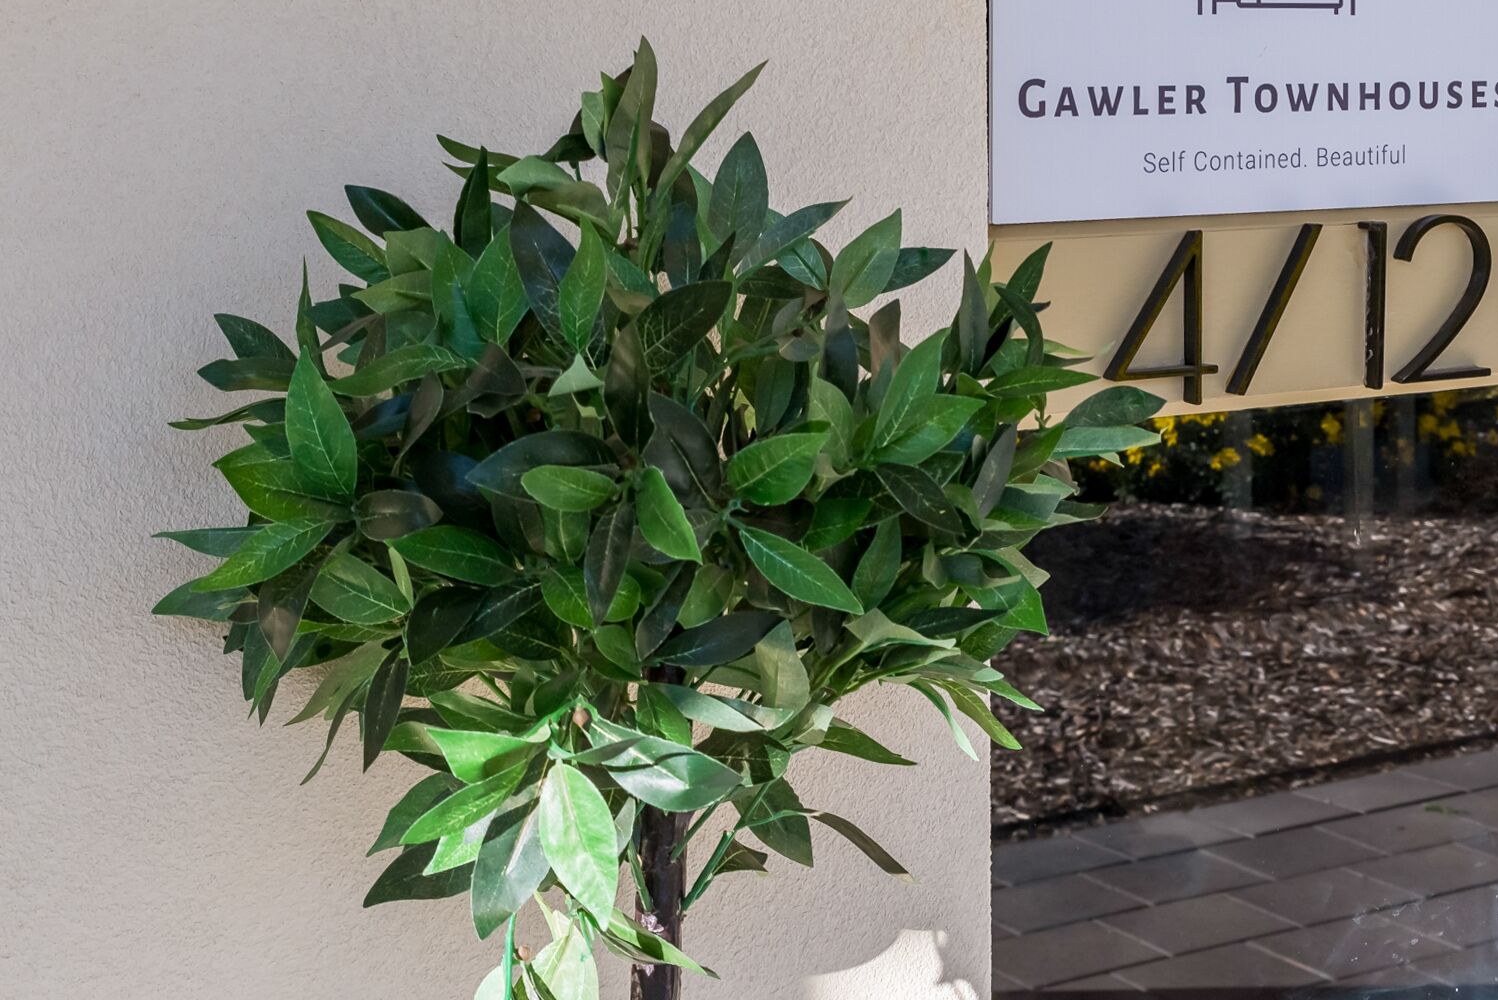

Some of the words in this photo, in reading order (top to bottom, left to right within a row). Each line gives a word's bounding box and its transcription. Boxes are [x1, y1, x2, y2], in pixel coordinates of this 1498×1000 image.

[1018, 78, 1207, 118] GAWLER
[1143, 149, 1186, 174] Self
[1194, 147, 1307, 172] Contained.
[1316, 143, 1406, 168] Beautiful
[1103, 213, 1493, 405] 4/12
